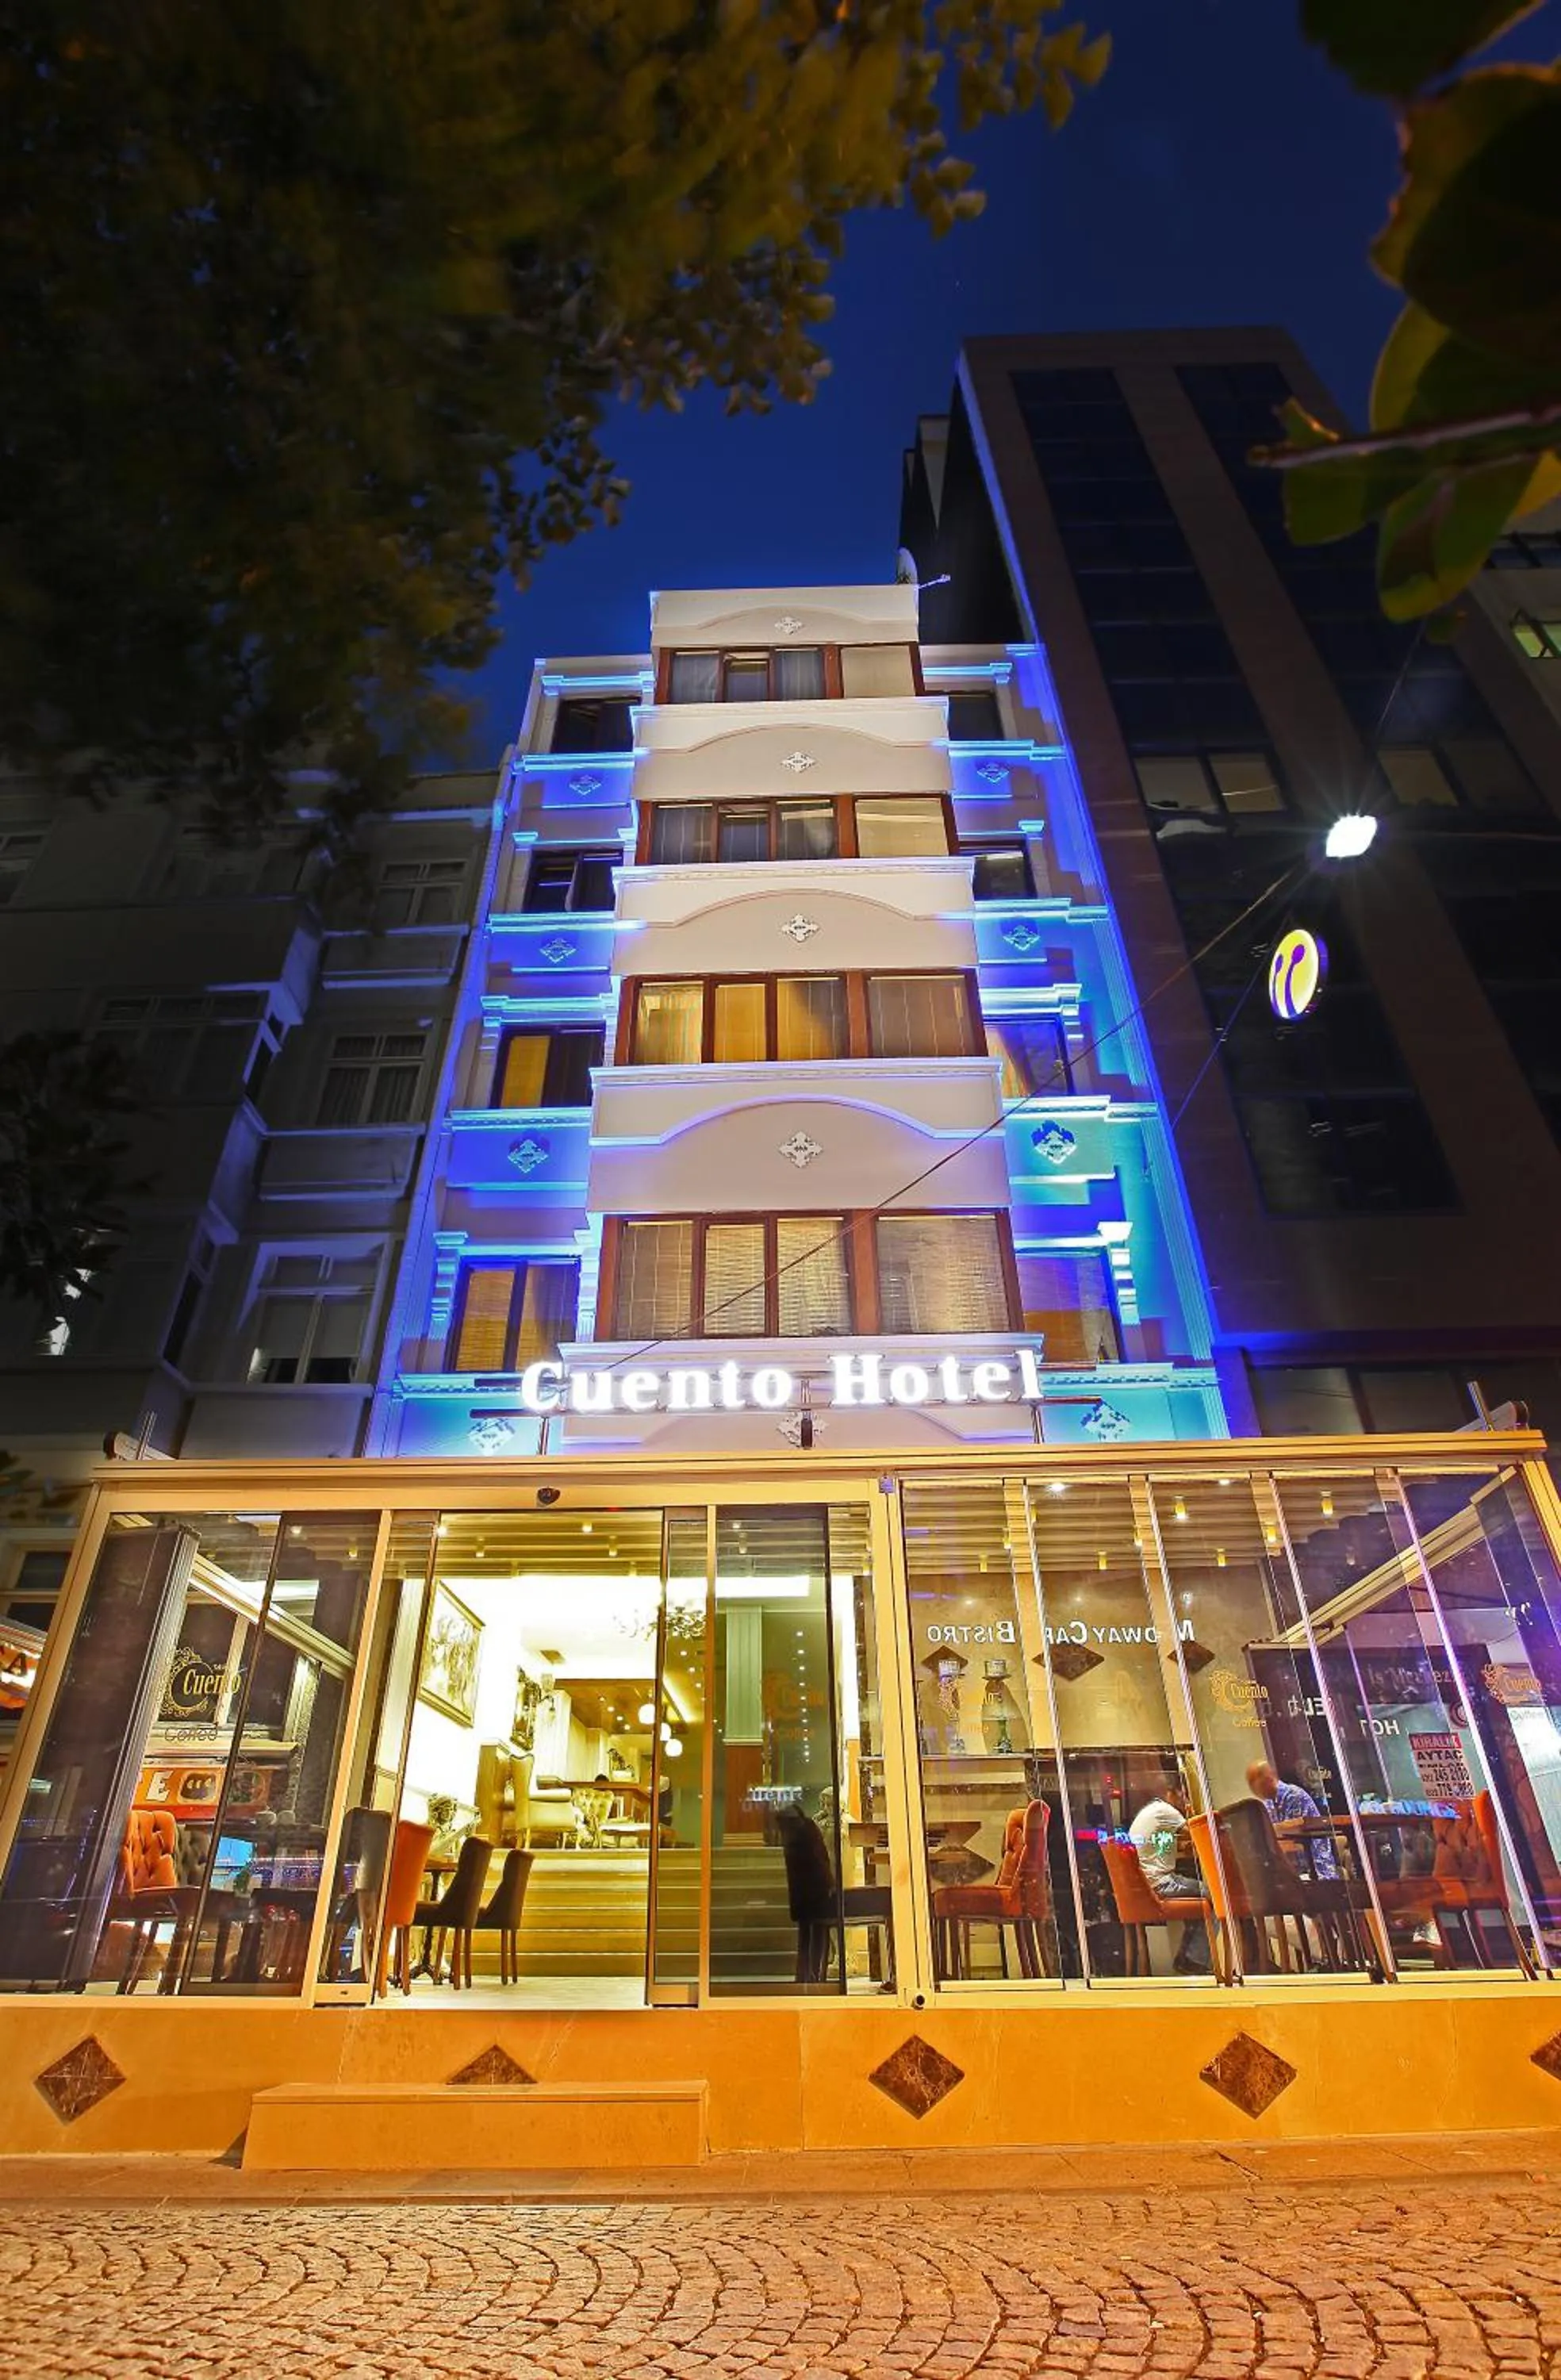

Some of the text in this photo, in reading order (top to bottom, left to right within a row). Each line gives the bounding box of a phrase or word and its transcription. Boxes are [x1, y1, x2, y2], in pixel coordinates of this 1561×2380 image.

[520, 1349, 1043, 1412] Cuento Hotel
[183, 1668, 242, 1695] Cueno
